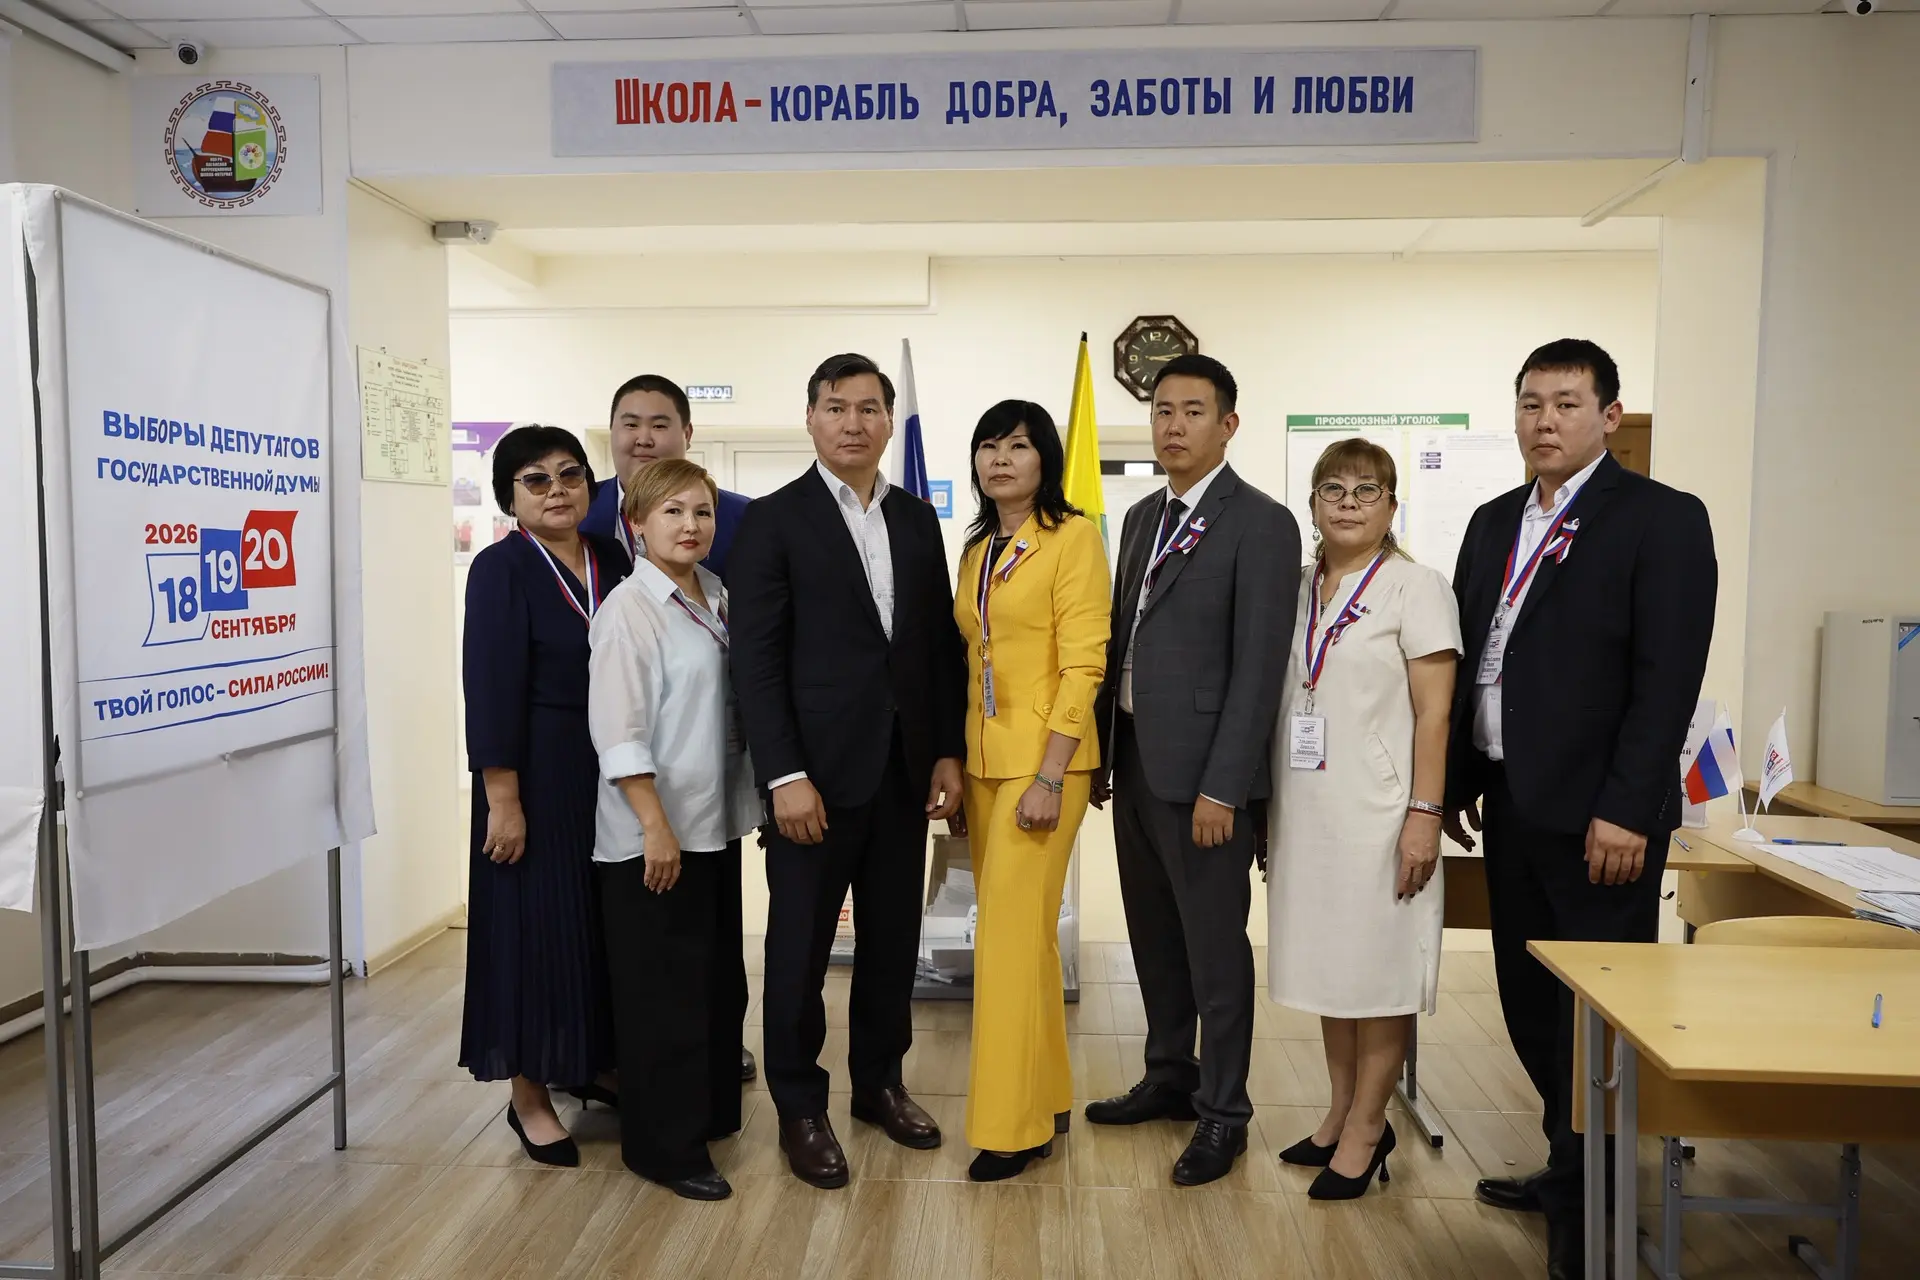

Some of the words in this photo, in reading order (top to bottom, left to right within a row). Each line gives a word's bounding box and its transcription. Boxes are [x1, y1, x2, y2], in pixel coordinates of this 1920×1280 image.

[770, 83, 920, 122] КОРАБЛЬ
[945, 80, 1068, 128] ДОБРА,
[1090, 77, 1231, 117] ЗАБОТЫ
[1254, 76, 1275, 114] И
[1293, 76, 1414, 114] ЛЮБВИ
[1150, 332, 1161, 341] 12
[1129, 354, 1138, 364] 9
[688, 387, 731, 398] ВЫХОД
[1315, 415, 1397, 426] ПРОФСОЮЗНЫЙ
[1400, 415, 1440, 425] УГОЛОК
[103, 410, 206, 447] ВЫБОРЫ
[210, 426, 320, 459] ДЕПУТАТОВ
[97, 457, 274, 492] ГОСУДАРСТВЕННОЙ
[274, 475, 320, 495] ДУМЫ
[145, 523, 198, 544] 2026
[158, 576, 198, 623] 18
[204, 550, 238, 594] 19
[244, 528, 289, 570] 20
[211, 613, 296, 640] СЕНТЯБРЯ
[94, 690, 153, 721] ТВОЙ
[228, 677, 274, 698] СИЛА
[276, 662, 329, 690] РОССИИ!
